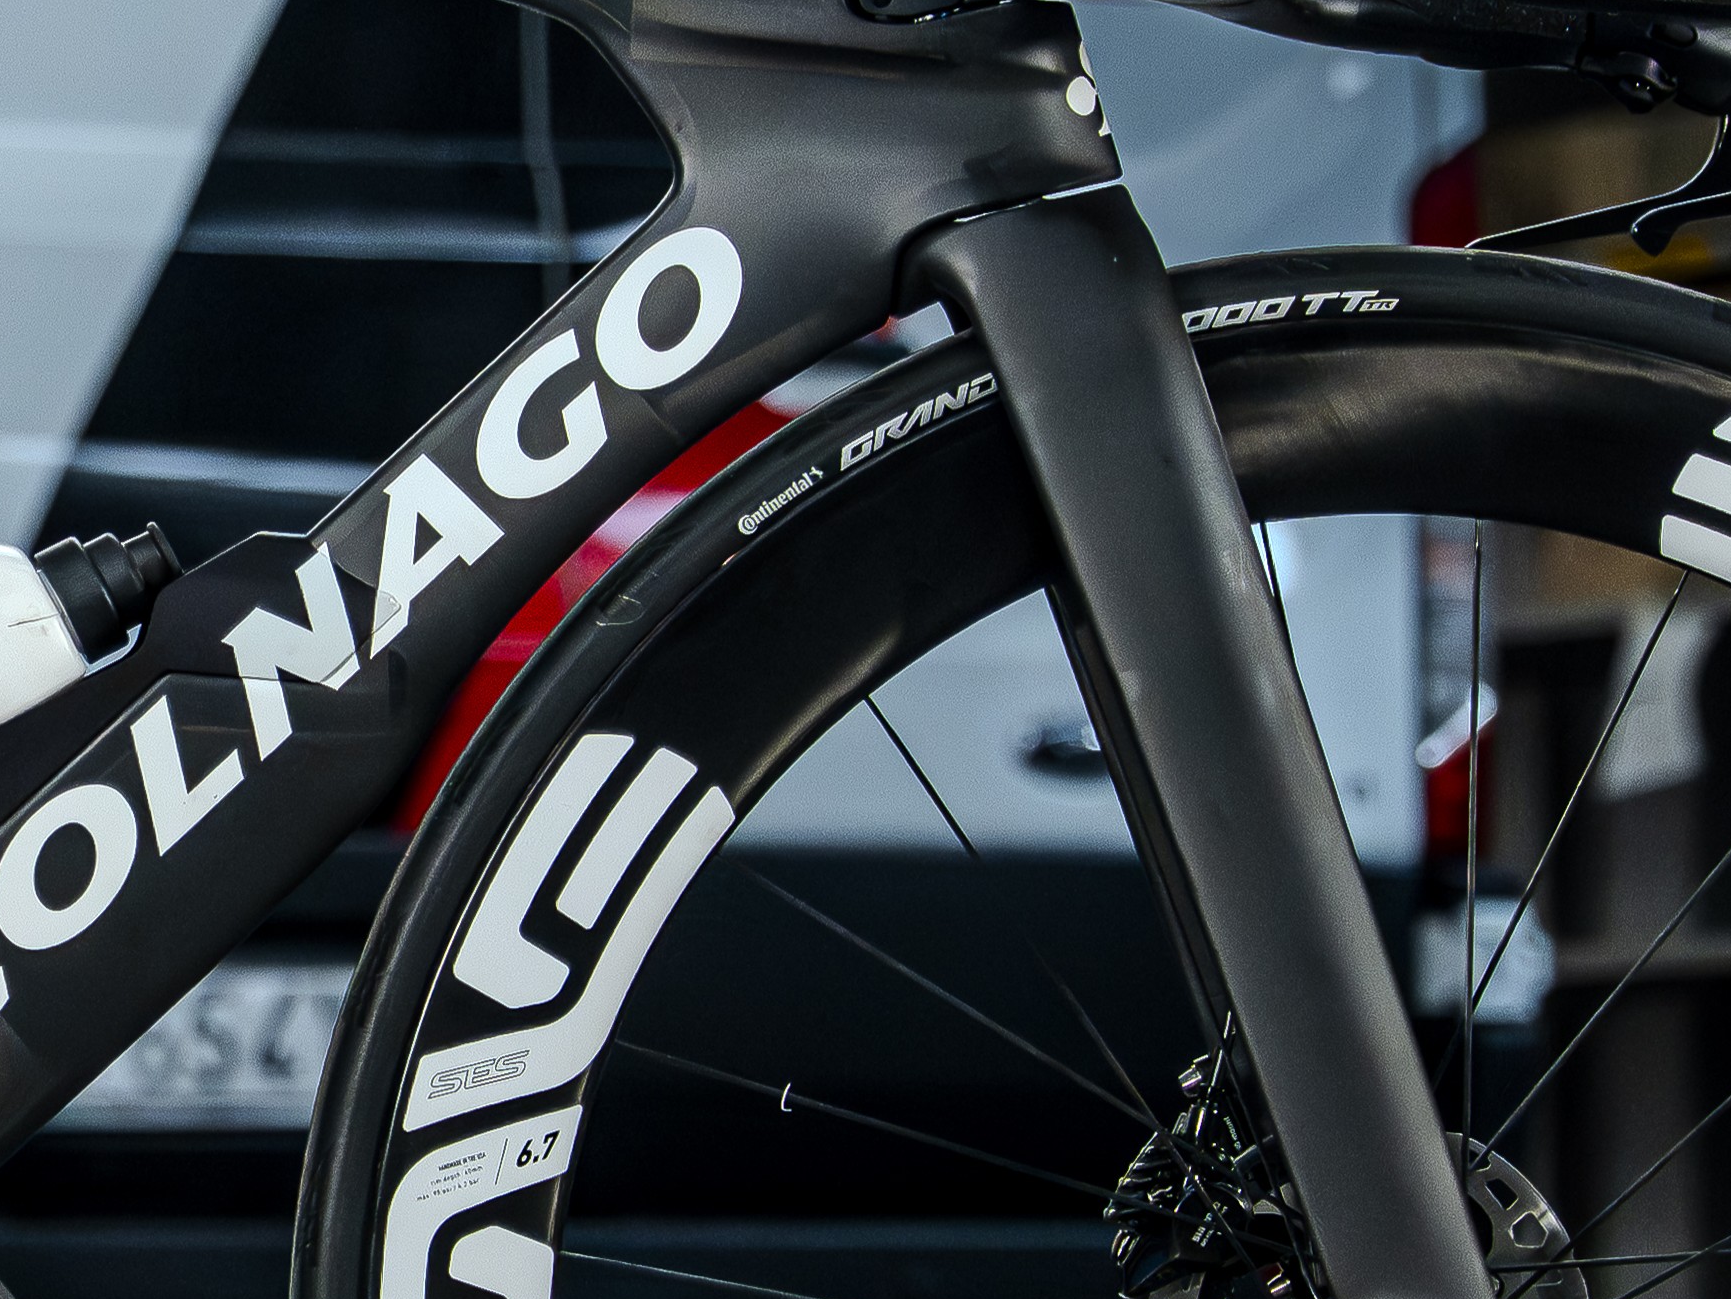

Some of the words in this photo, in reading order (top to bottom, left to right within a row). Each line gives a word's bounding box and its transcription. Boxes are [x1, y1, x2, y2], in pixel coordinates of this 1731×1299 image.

[738, 472, 814, 536] Continental
[840, 372, 999, 471] GRAND
[427, 1049, 531, 1100] SES
[515, 1129, 561, 1169] 6.7
